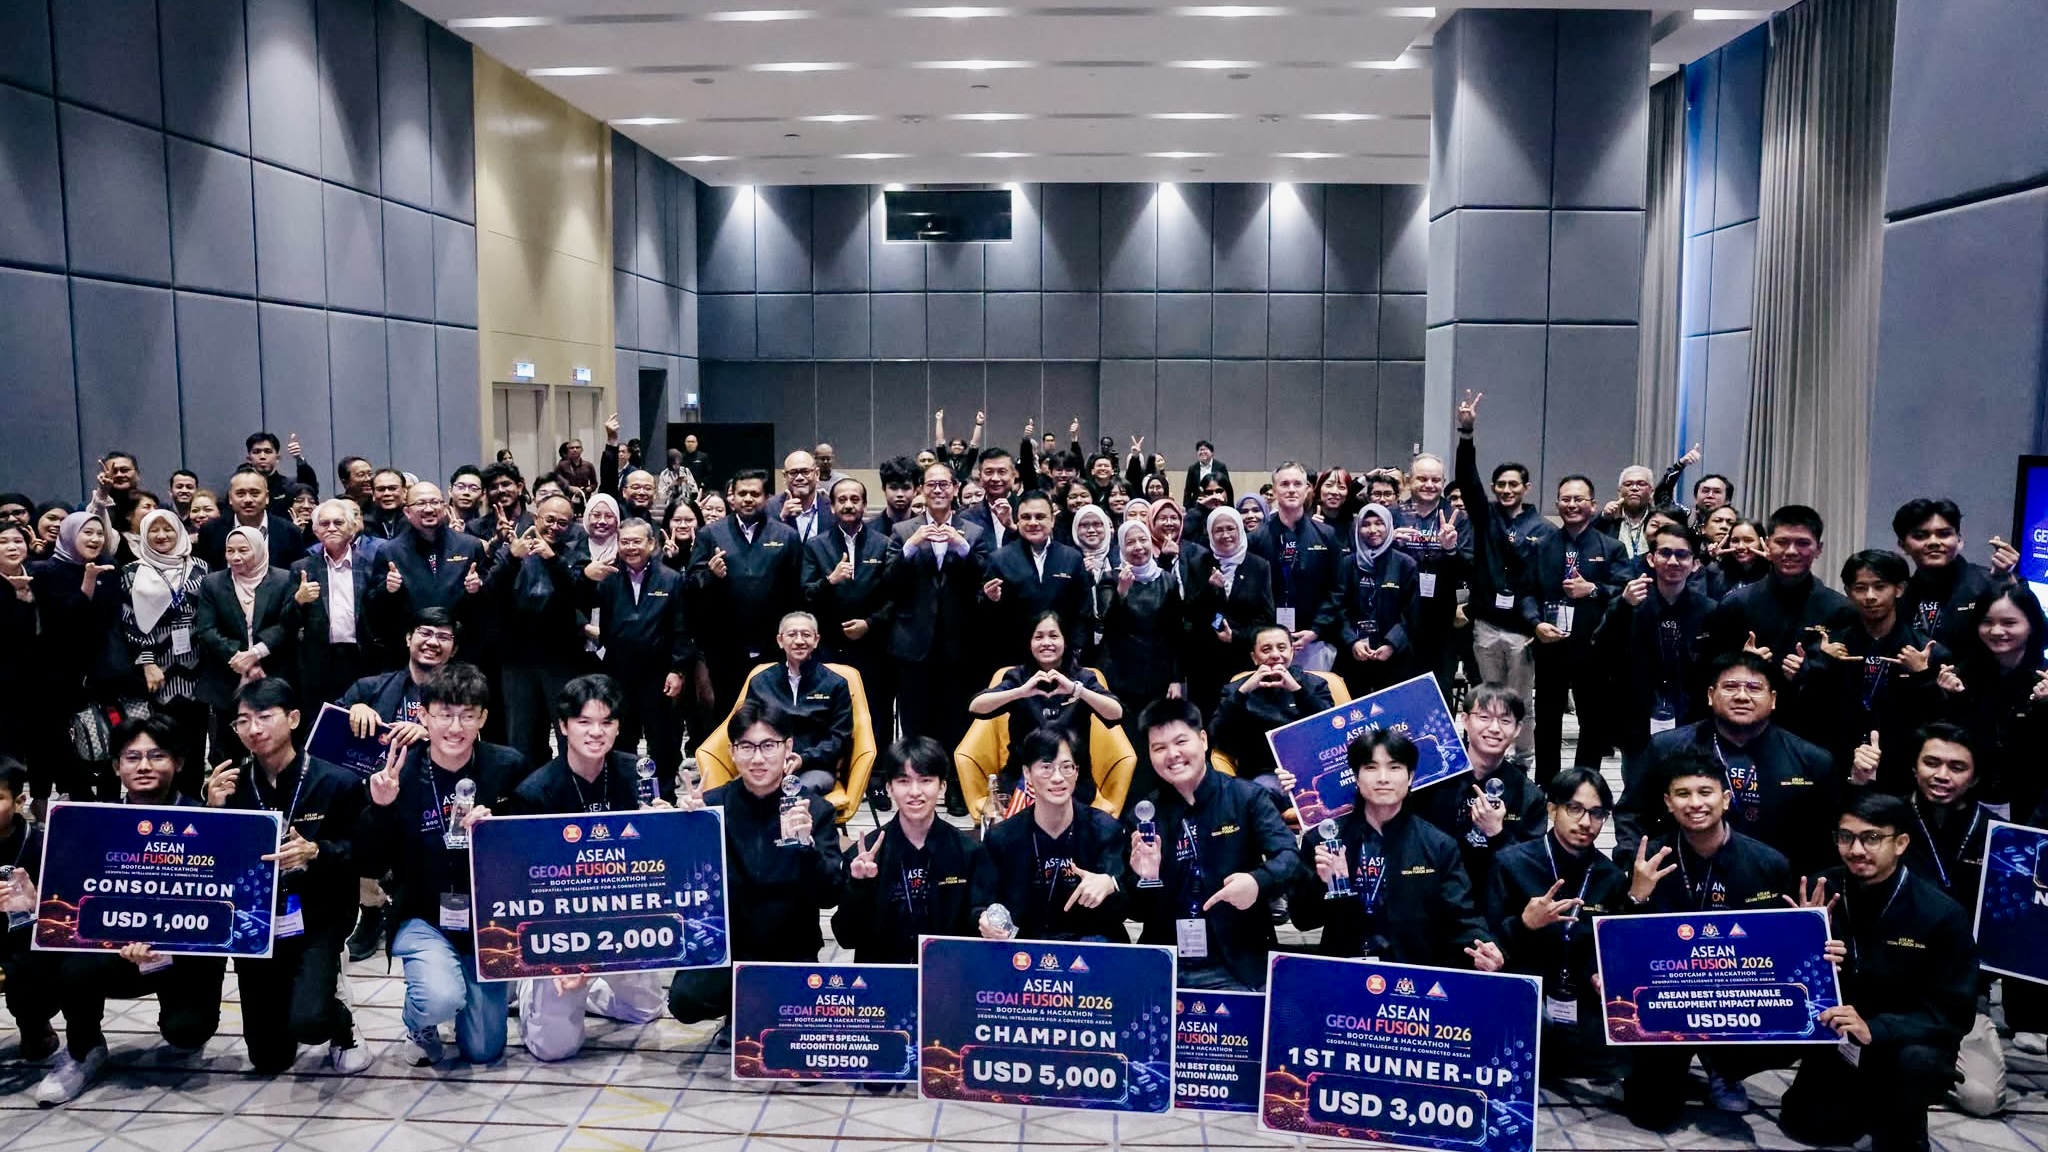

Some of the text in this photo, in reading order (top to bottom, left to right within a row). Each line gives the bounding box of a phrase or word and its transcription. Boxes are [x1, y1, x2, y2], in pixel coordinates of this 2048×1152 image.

[144, 842, 184, 853] ASEAN
[105, 852, 214, 866] GEOAI FUSION 2026
[576, 848, 625, 862] ASEAN
[529, 860, 665, 879] GEOAI FUSION 2026
[83, 878, 234, 897] CONSOLATION
[550, 878, 591, 886] BOOTCAMP
[492, 890, 709, 917] 2ND RUNNER-UP
[102, 911, 209, 932] USD 1,000
[530, 927, 674, 954] USD 2,000
[1691, 945, 1735, 958] ASEAN
[1650, 957, 1773, 971] GEOAI FUSION 2026
[1023, 978, 1073, 993] ASEAN
[816, 995, 855, 1006] ASEAN
[976, 990, 1112, 1010] GEOAI FUSION 2026
[1658, 989, 1781, 999] ASEAN BEST SUSTAINABLE
[779, 1005, 885, 1017] GEOAI FUSION 2026
[1648, 999, 1793, 1009] DEVELOPMENT IMPACT AWARD
[1376, 1003, 1430, 1022] ASEAN
[1178, 1021, 1217, 1033] ASEAN
[1326, 1014, 1472, 1042] GEOAI FUSION 2026
[1687, 1014, 1761, 1028] USD500
[836, 1034, 870, 1042] SPECIAL
[975, 1024, 1116, 1048] CHAMPION
[1177, 1032, 1248, 1046] FUSION 2026
[1347, 1033, 1390, 1042] BOOTCAMP
[1401, 1038, 1450, 1048] HACKATHON
[806, 1055, 868, 1068] USD500
[1188, 1062, 1208, 1070] BEST
[1210, 1064, 1235, 1072] GEOAI
[1288, 1047, 1513, 1087] 1ST RUNNER-UP
[973, 1060, 1116, 1090] USD 5,000
[1176, 1071, 1238, 1081] VATION AWARD
[1176, 1084, 1228, 1098] SD500
[1319, 1089, 1473, 1128] USD 3,000
